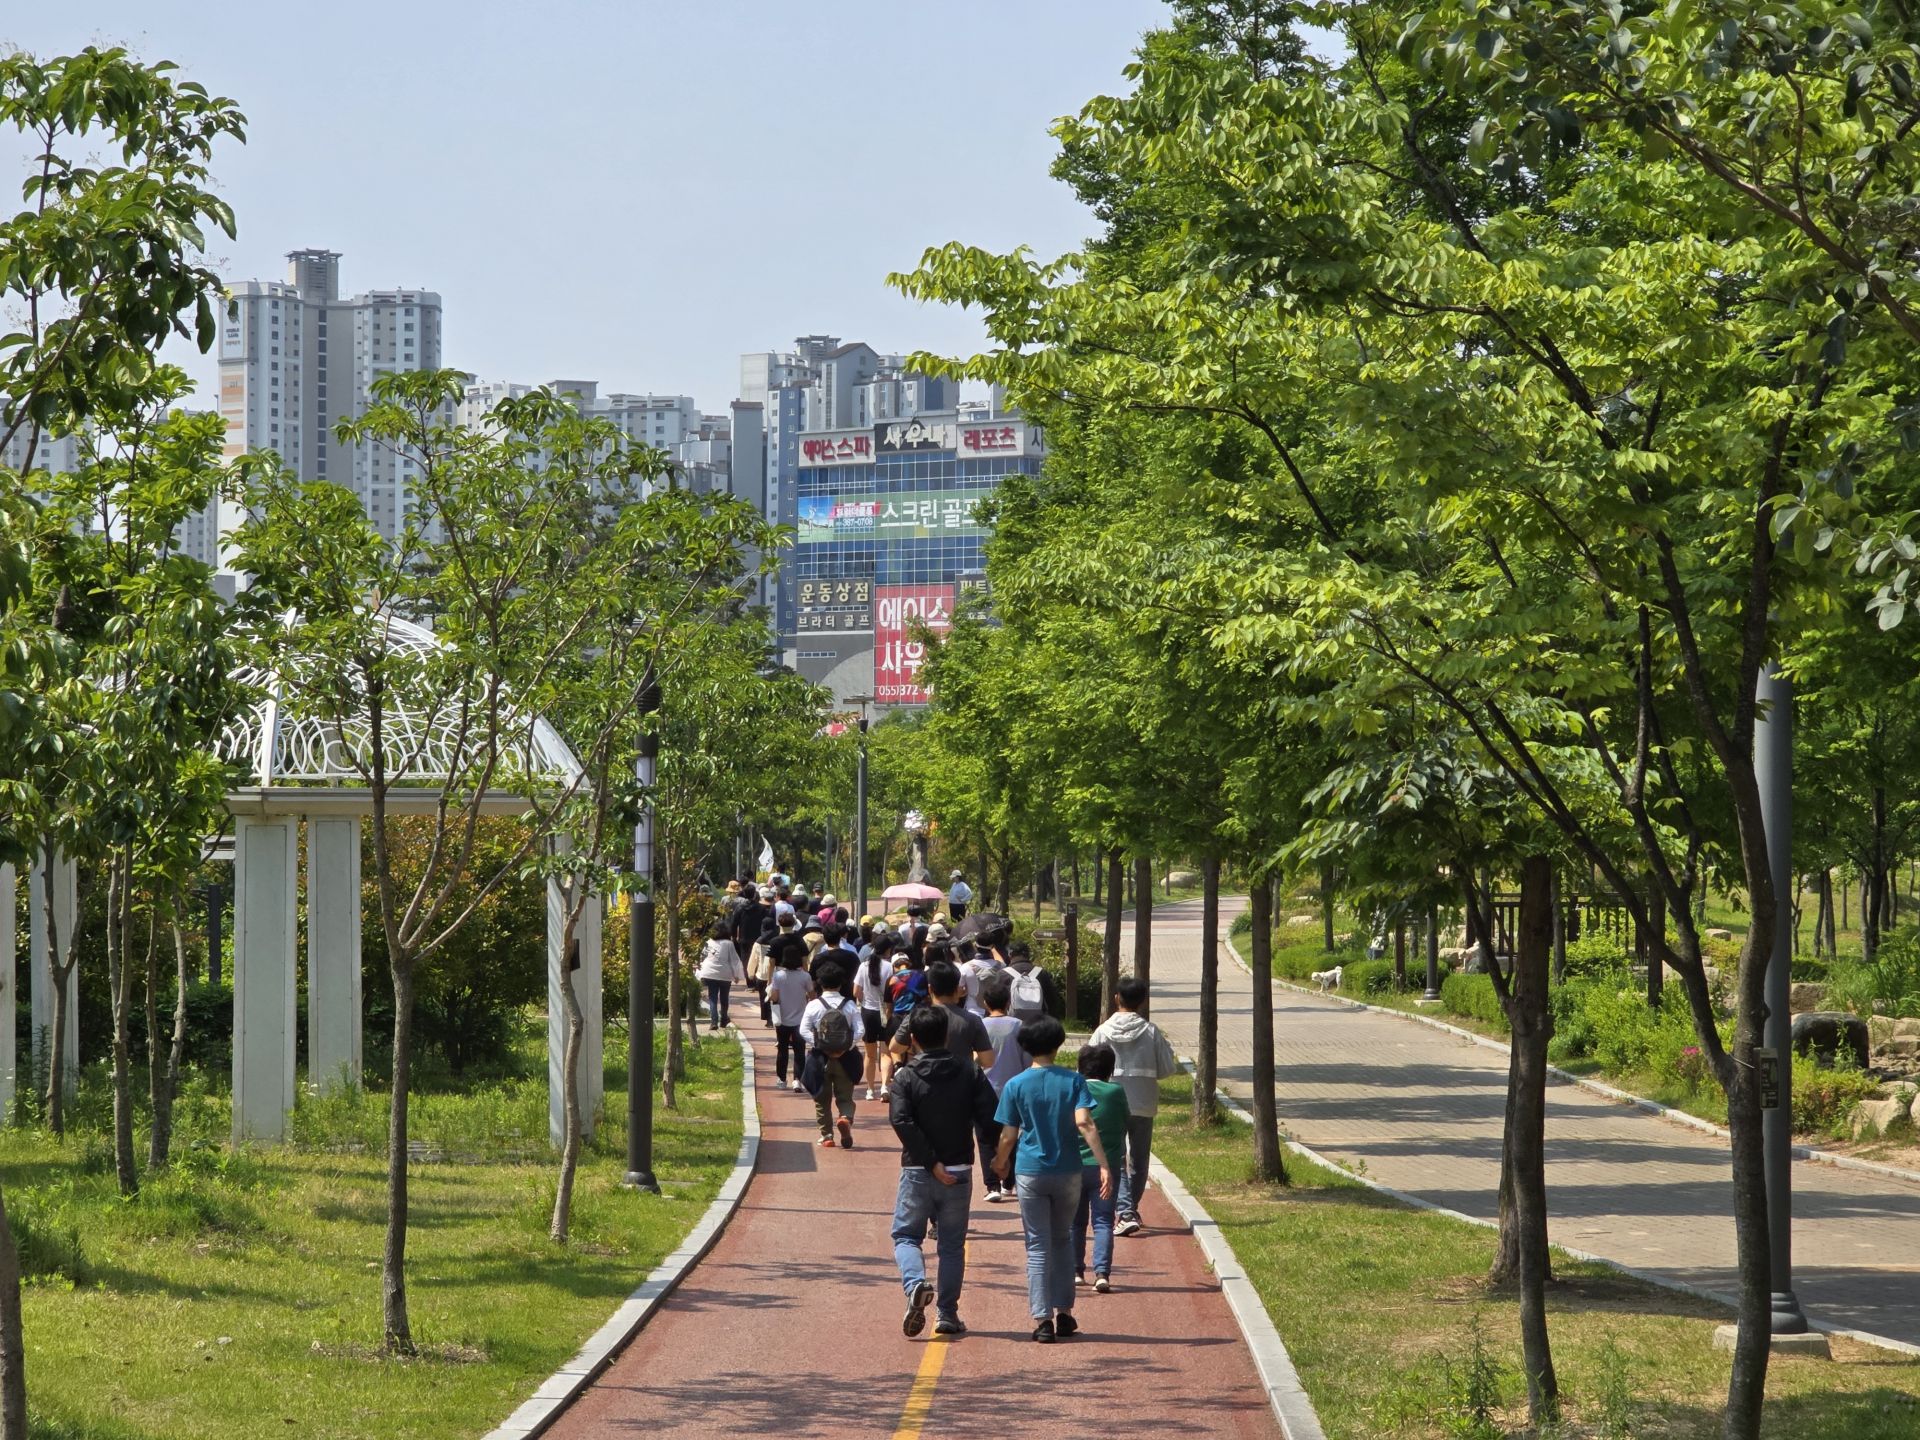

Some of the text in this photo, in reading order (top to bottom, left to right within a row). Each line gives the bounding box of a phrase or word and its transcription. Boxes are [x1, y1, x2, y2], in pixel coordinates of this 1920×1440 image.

[884, 423, 945, 449] 사우나
[963, 427, 1016, 450] 레포츠
[801, 582, 868, 603] 운동상점
[879, 597, 950, 630] 에이스
[881, 640, 940, 675] 사우
